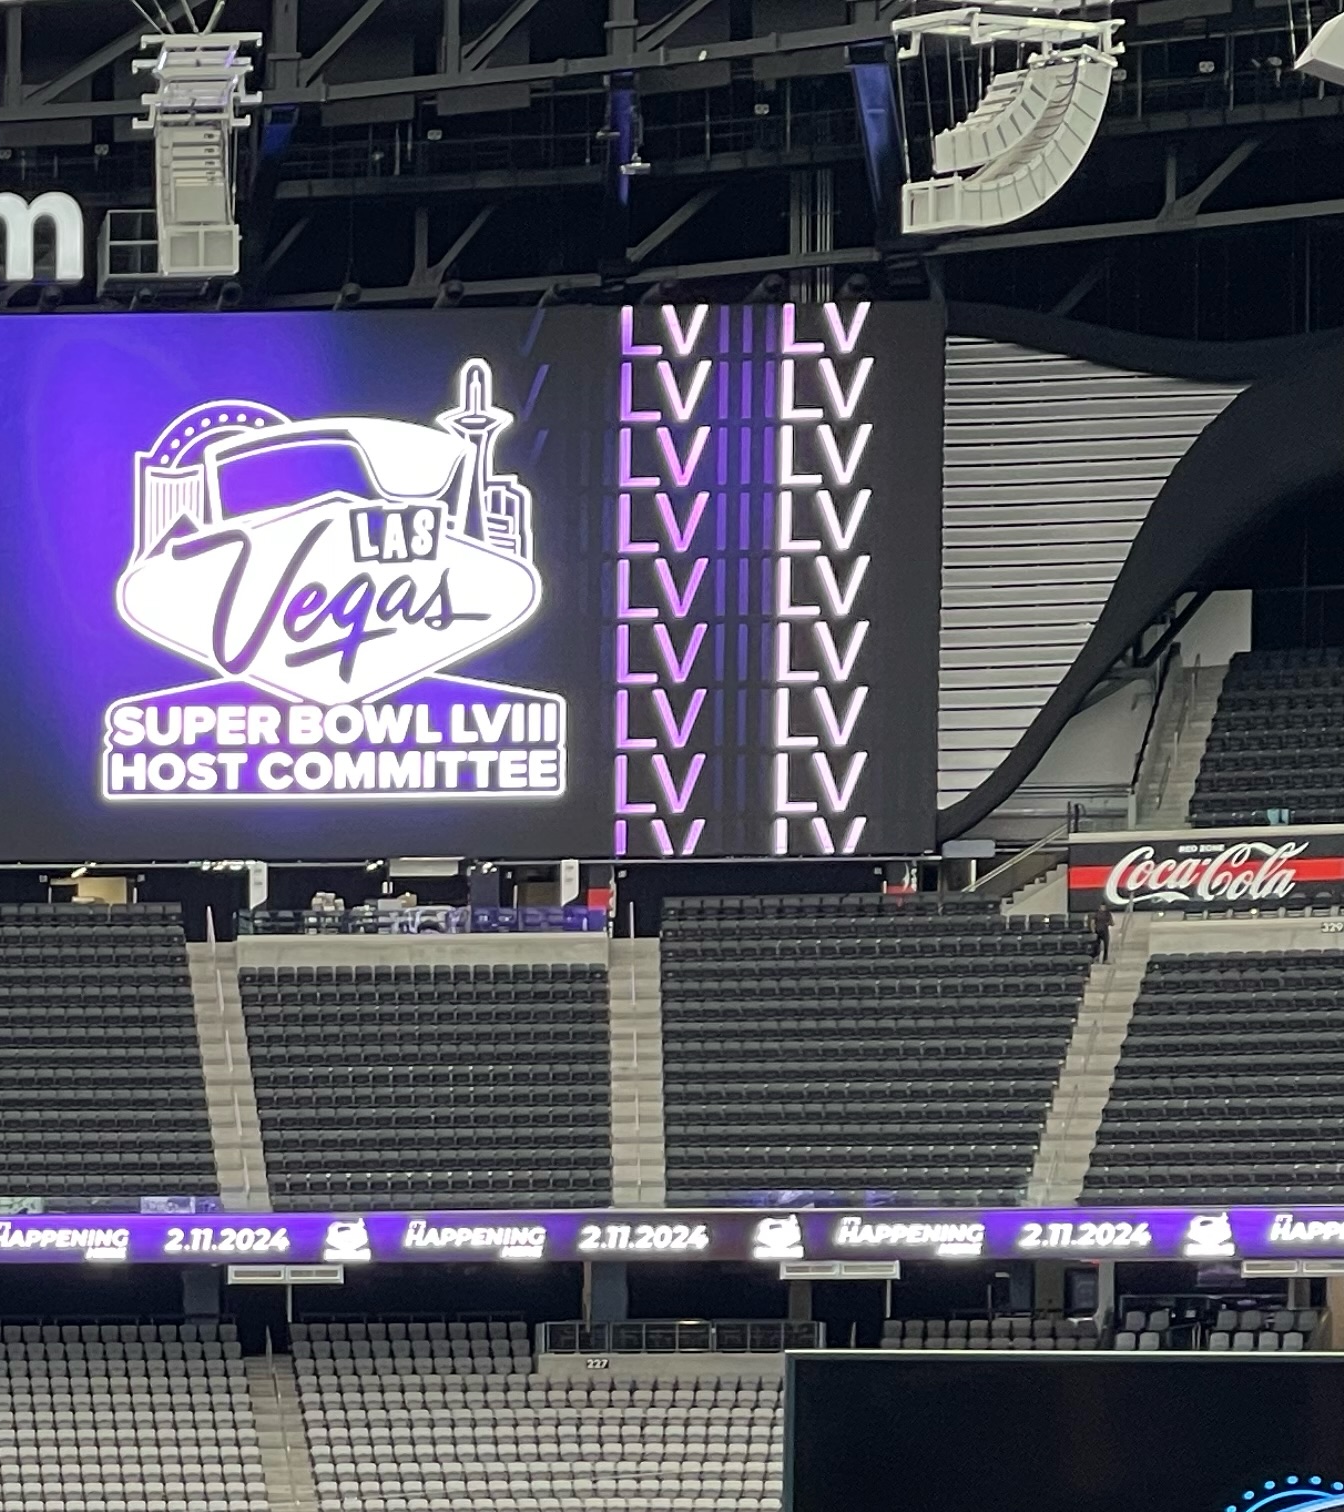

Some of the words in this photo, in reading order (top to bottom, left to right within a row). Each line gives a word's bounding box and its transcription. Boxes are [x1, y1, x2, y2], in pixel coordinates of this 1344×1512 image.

[357, 510, 436, 562] LAS
[172, 519, 491, 685] Vegas
[112, 704, 280, 747] SUPER
[289, 704, 446, 747] BOWL
[451, 703, 558, 747] LVIII
[111, 752, 250, 792] HOST
[258, 752, 558, 792] COMMITTEE
[165, 1228, 289, 1250] 2.11.2024
[579, 1225, 708, 1249] 2.11.2024
[1020, 1223, 1151, 1246] 2.11.2024
[1271, 1220, 1344, 1240] HAPP
[587, 1359, 609, 1368] 227
